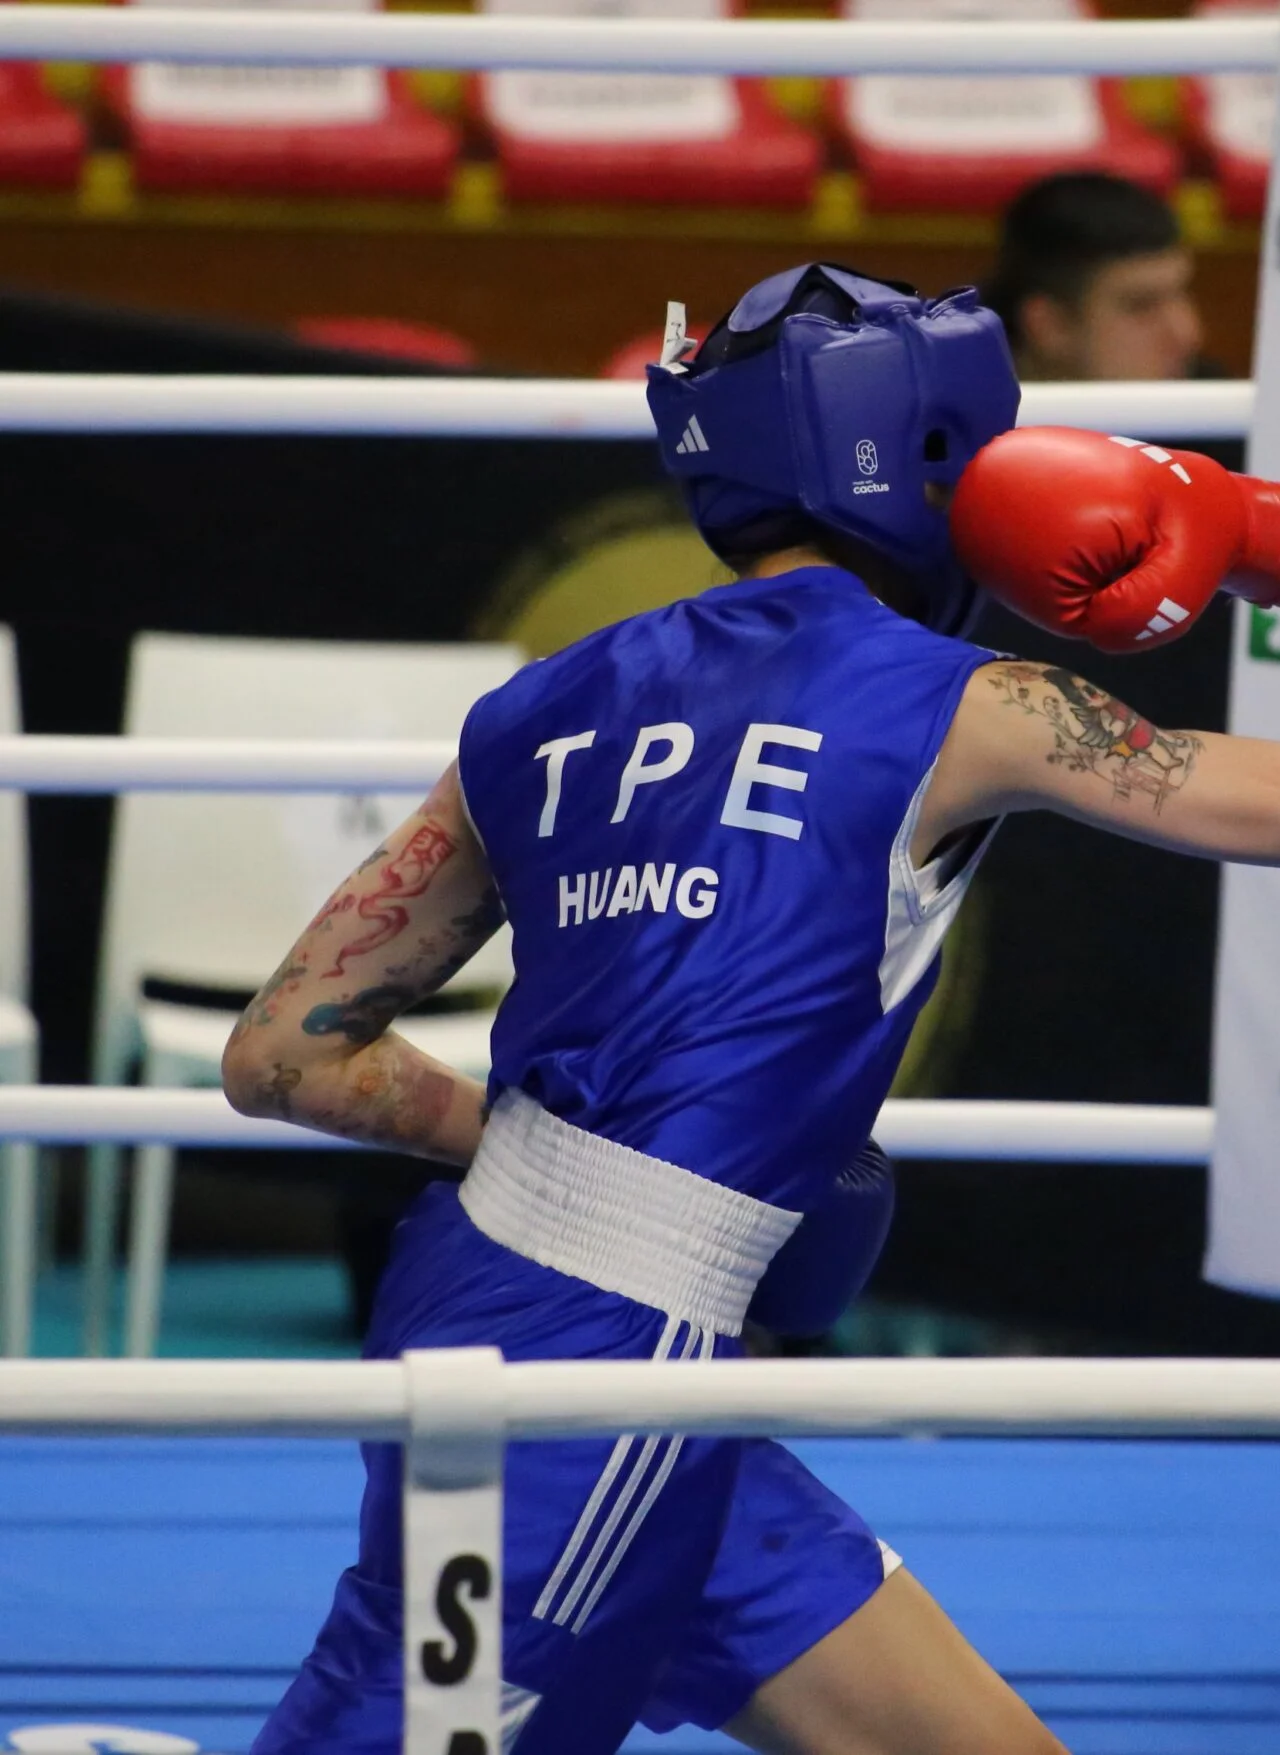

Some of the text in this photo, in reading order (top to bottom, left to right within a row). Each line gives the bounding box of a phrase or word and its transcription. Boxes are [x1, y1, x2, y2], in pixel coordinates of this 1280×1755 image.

[853, 483, 889, 494] cactus
[533, 721, 824, 841] TPE
[558, 862, 719, 929] HUANG
